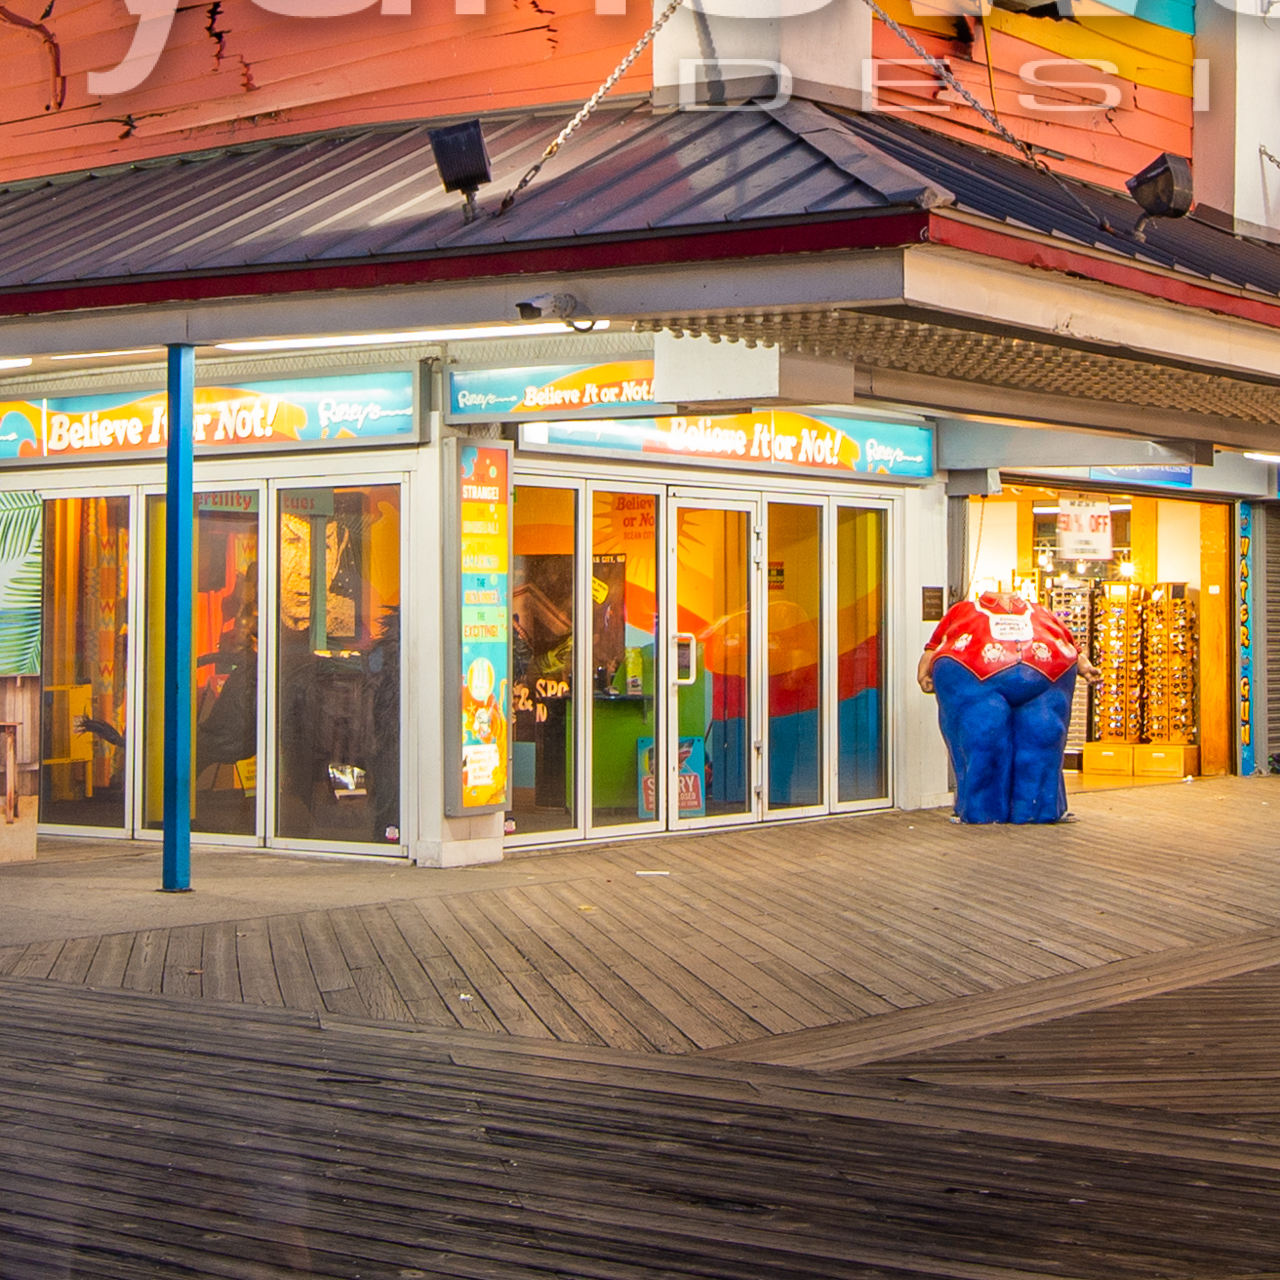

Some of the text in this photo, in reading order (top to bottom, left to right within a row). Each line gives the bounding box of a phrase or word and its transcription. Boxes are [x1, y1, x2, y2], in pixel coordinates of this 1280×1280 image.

[523, 385, 580, 407] Believe
[582, 383, 600, 403] It
[600, 385, 620, 401] or
[622, 379, 656, 402] Not!
[48, 410, 143, 450] Believe
[213, 395, 281, 439] Not!
[668, 417, 747, 456] Believe
[750, 422, 770, 458] It
[772, 432, 797, 459] or
[800, 429, 844, 465] Not!
[198, 492, 252, 510] ertility
[462, 485, 499, 500] STRANGE!
[616, 497, 655, 512] Believ
[623, 515, 637, 527] or
[624, 531, 641, 540] OCEAN
[1240, 536, 1250, 648] WATER
[463, 624, 499, 638] EXCITING!
[1240, 676, 1250, 746] GUN
[647, 775, 695, 795] SRY
